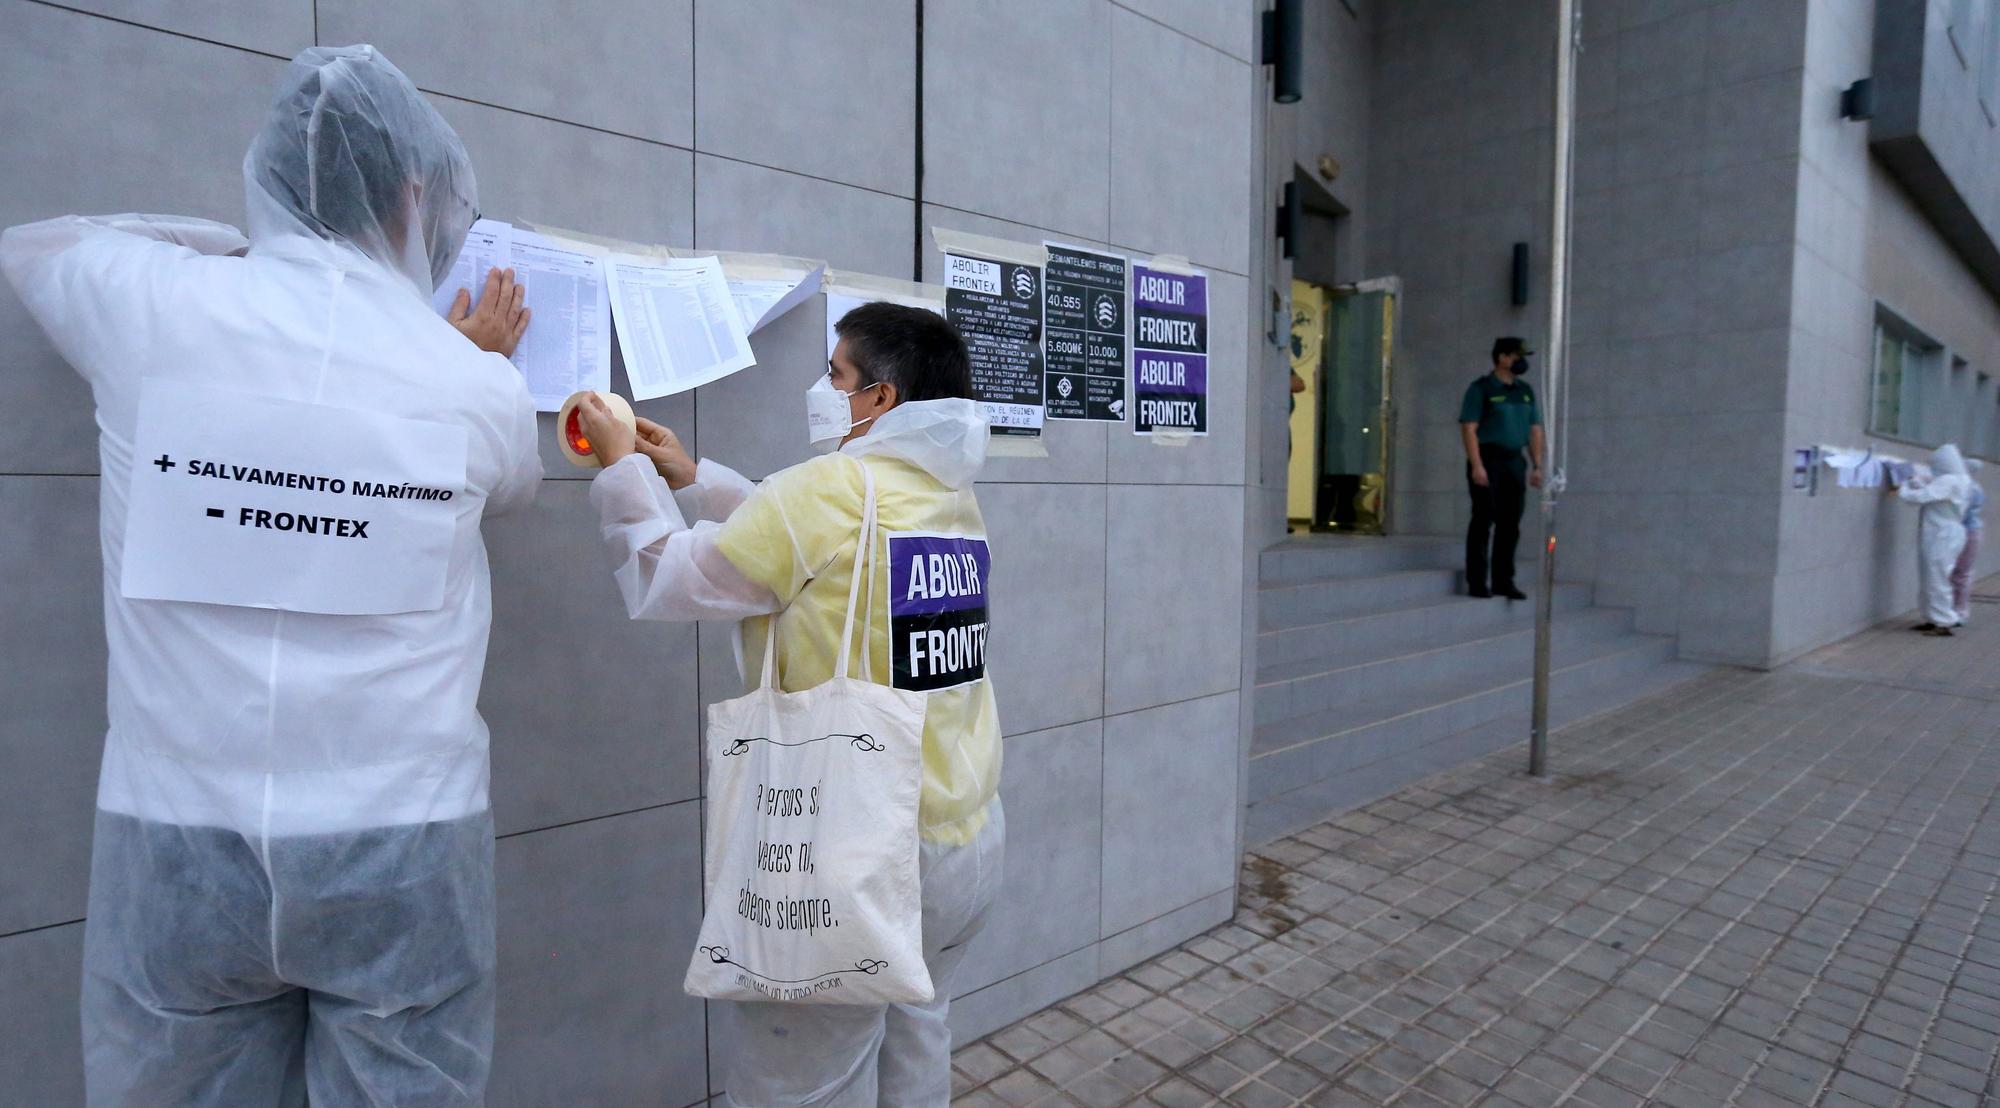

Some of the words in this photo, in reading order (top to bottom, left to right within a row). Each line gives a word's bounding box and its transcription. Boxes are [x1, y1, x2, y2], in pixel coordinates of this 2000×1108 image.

[952, 260, 989, 274] ABOLIR
[952, 276, 996, 292] FRONTEX
[1139, 276, 1185, 306] ABOLIR
[1048, 294, 1081, 310] 40.555
[1140, 316, 1196, 346] FRONTEX
[1048, 340, 1083, 354] 5.600M€
[1089, 345, 1117, 358] 10.000
[1140, 360, 1185, 386] ABOLIR
[1002, 416, 1008, 424] DE
[1141, 400, 1197, 425] FRONTEX
[188, 459, 346, 494] SALVAMENTO
[352, 482, 453, 501] MARÍTIMO
[239, 507, 370, 539] FRONTEX
[907, 553, 981, 600] ABOLIR
[910, 621, 988, 677] FRONTE
